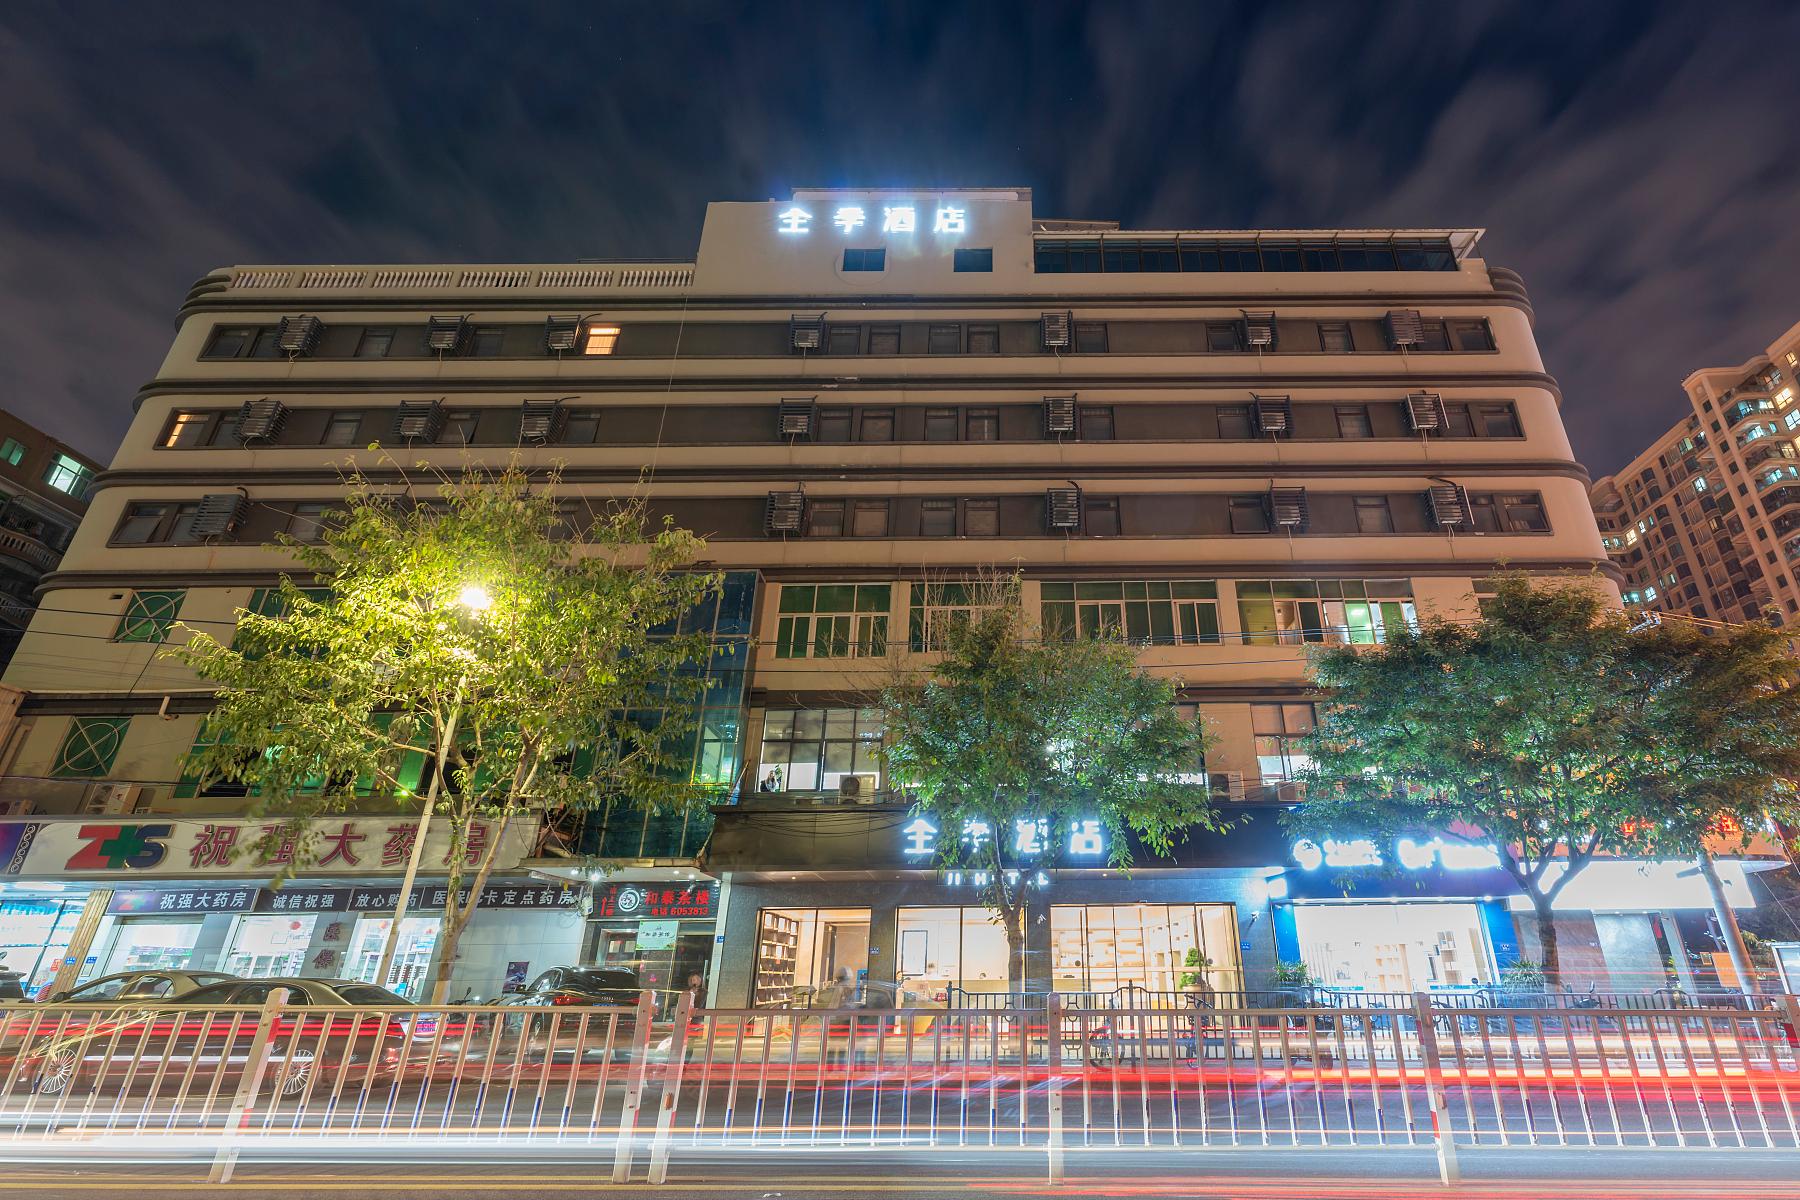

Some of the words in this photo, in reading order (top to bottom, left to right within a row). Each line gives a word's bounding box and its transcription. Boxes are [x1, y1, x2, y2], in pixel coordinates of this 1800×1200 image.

[778, 206, 966, 234] 全季酒店
[159, 892, 247, 909] 祝强大药房
[272, 894, 335, 909] 诚信祝强
